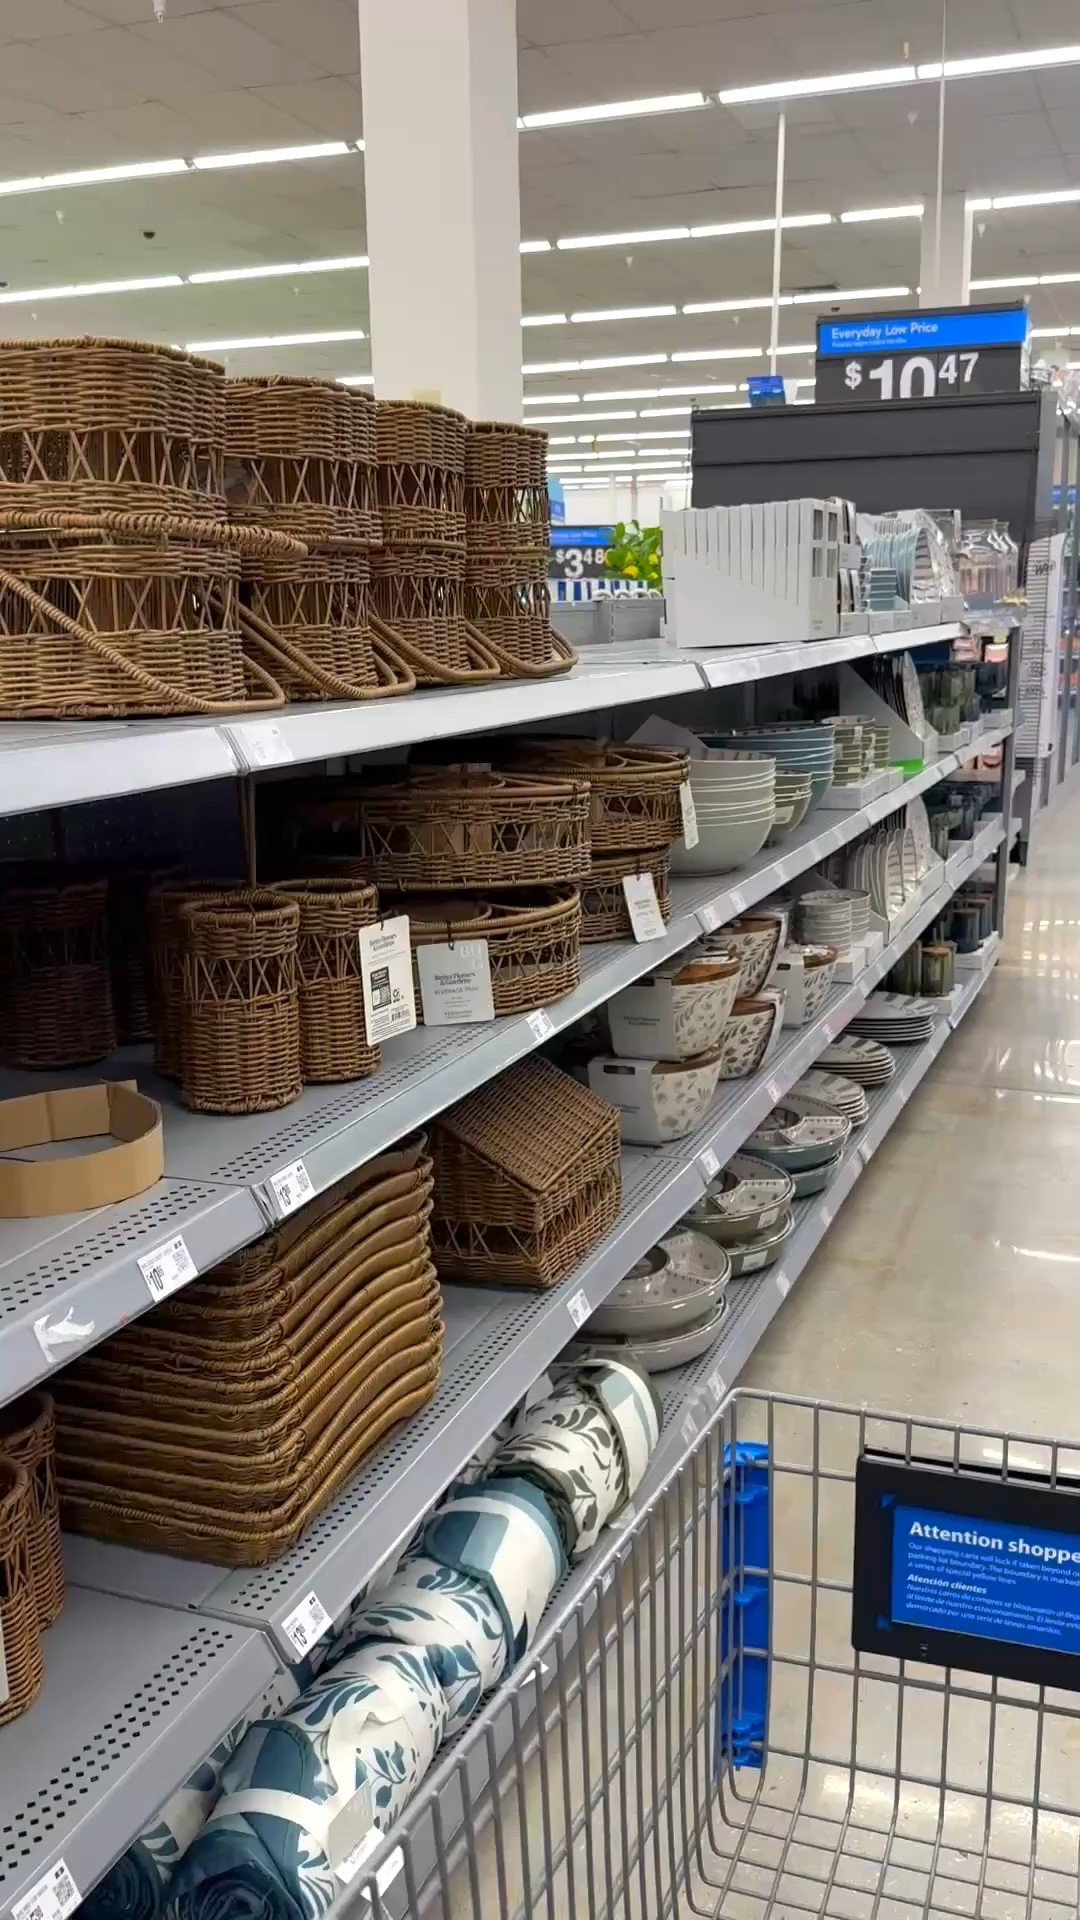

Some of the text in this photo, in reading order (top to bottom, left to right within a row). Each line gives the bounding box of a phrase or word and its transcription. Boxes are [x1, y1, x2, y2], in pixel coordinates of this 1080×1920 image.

[831, 321, 939, 341] Everyday Low Price
[909, 1521, 1003, 1550] Attention
[1019, 1560, 1040, 1570] taken
[1041, 1564, 1070, 1577] beyond
[907, 1573, 986, 1594] Atención clientes
